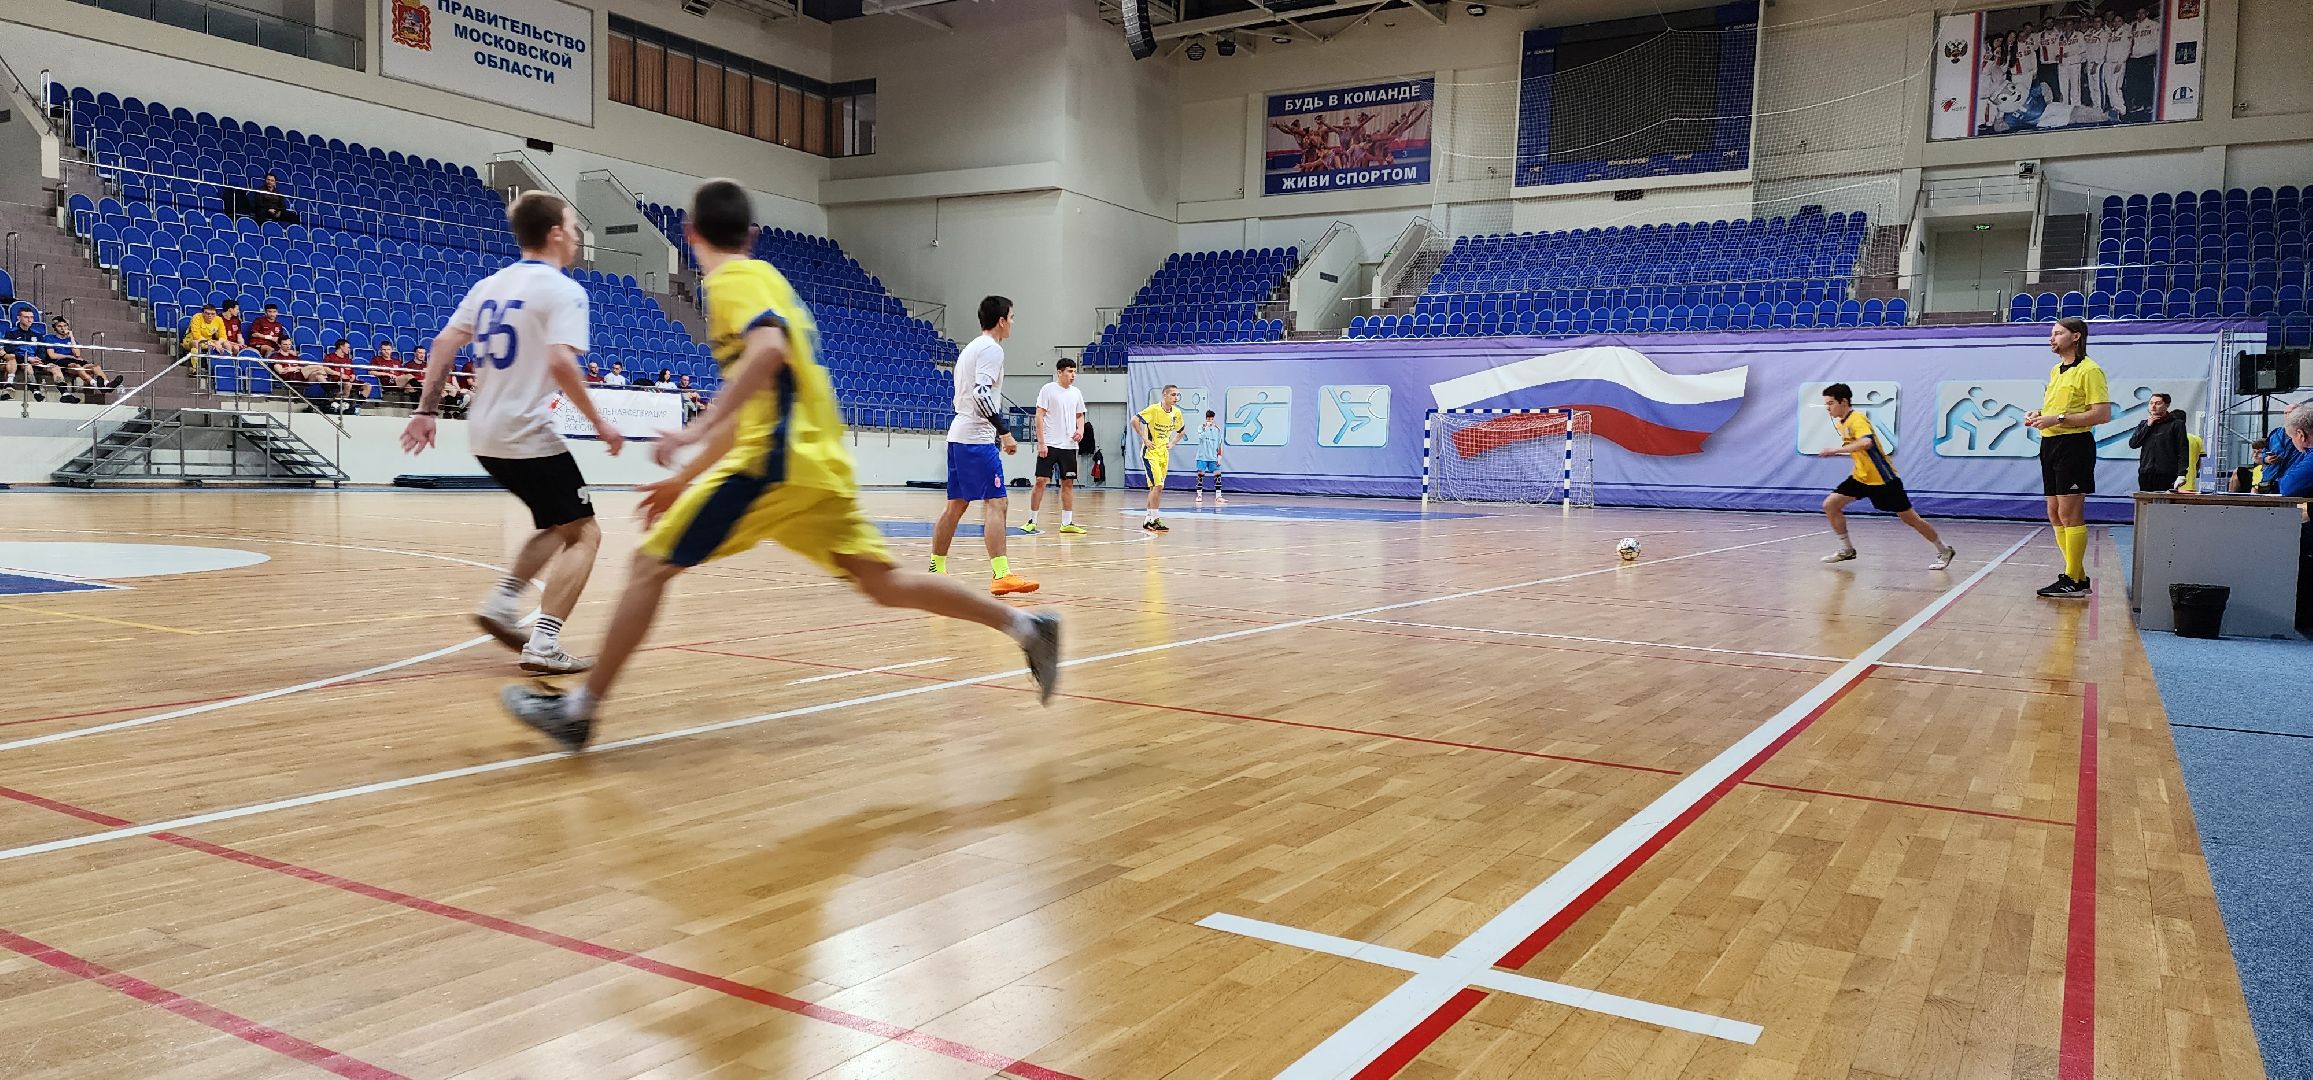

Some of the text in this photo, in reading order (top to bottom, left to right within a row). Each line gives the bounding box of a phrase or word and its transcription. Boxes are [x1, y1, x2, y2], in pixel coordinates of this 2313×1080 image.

[437, 0, 586, 53] ПРАВИТЕЛЬСТВО
[454, 23, 572, 69] МОСКОВСКОЙ
[474, 51, 555, 84] ОБЛАСТИ
[1285, 84, 1421, 111] БУДЬ В КОМАНДЕ
[1282, 166, 1417, 190] ЖИВИ СПОРТОМ
[473, 299, 525, 370] 95
